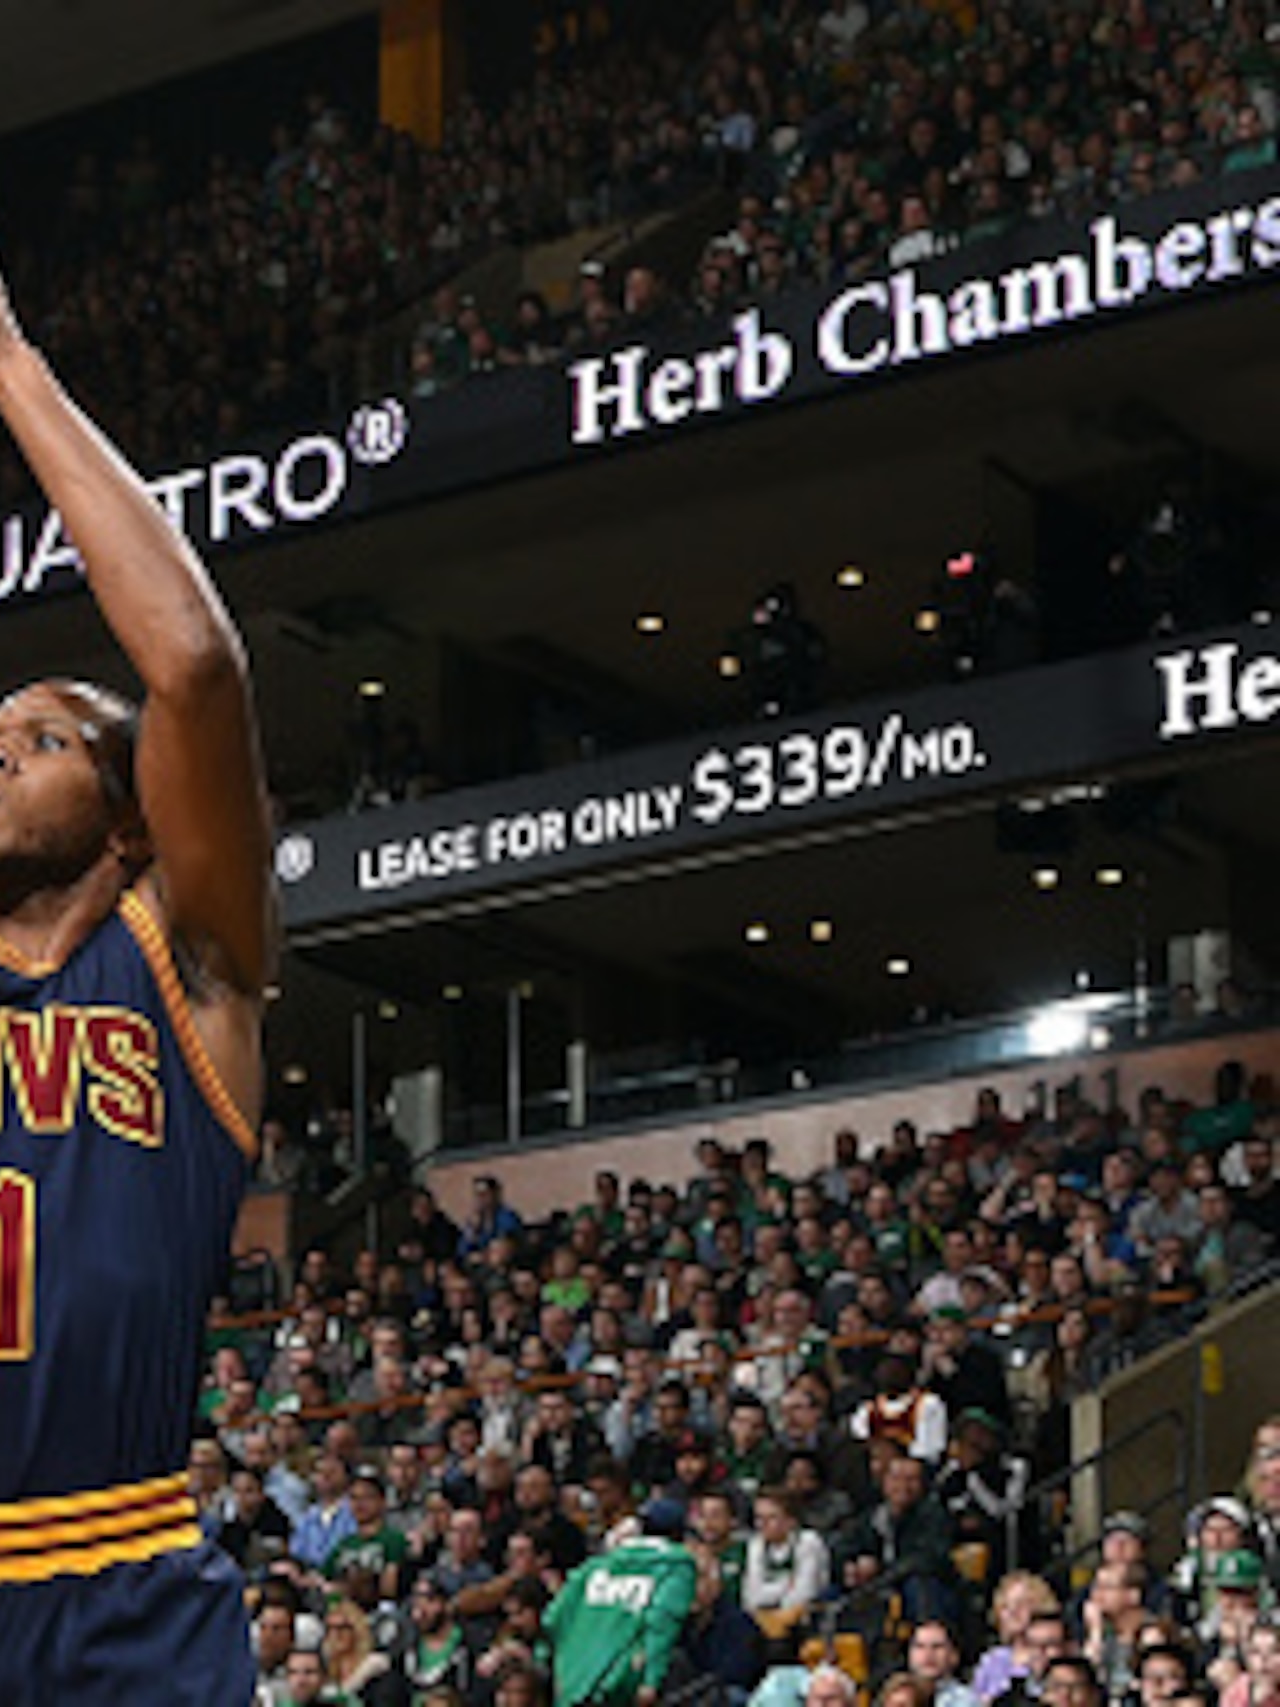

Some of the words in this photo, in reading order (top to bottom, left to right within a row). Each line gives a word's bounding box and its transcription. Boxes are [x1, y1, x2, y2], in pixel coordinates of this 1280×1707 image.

[568, 309, 793, 444] Herb
[817, 197, 1280, 373] Chambers
[358, 825, 480, 890] LEASE
[486, 810, 567, 863] FOR
[572, 785, 683, 844] ONLY
